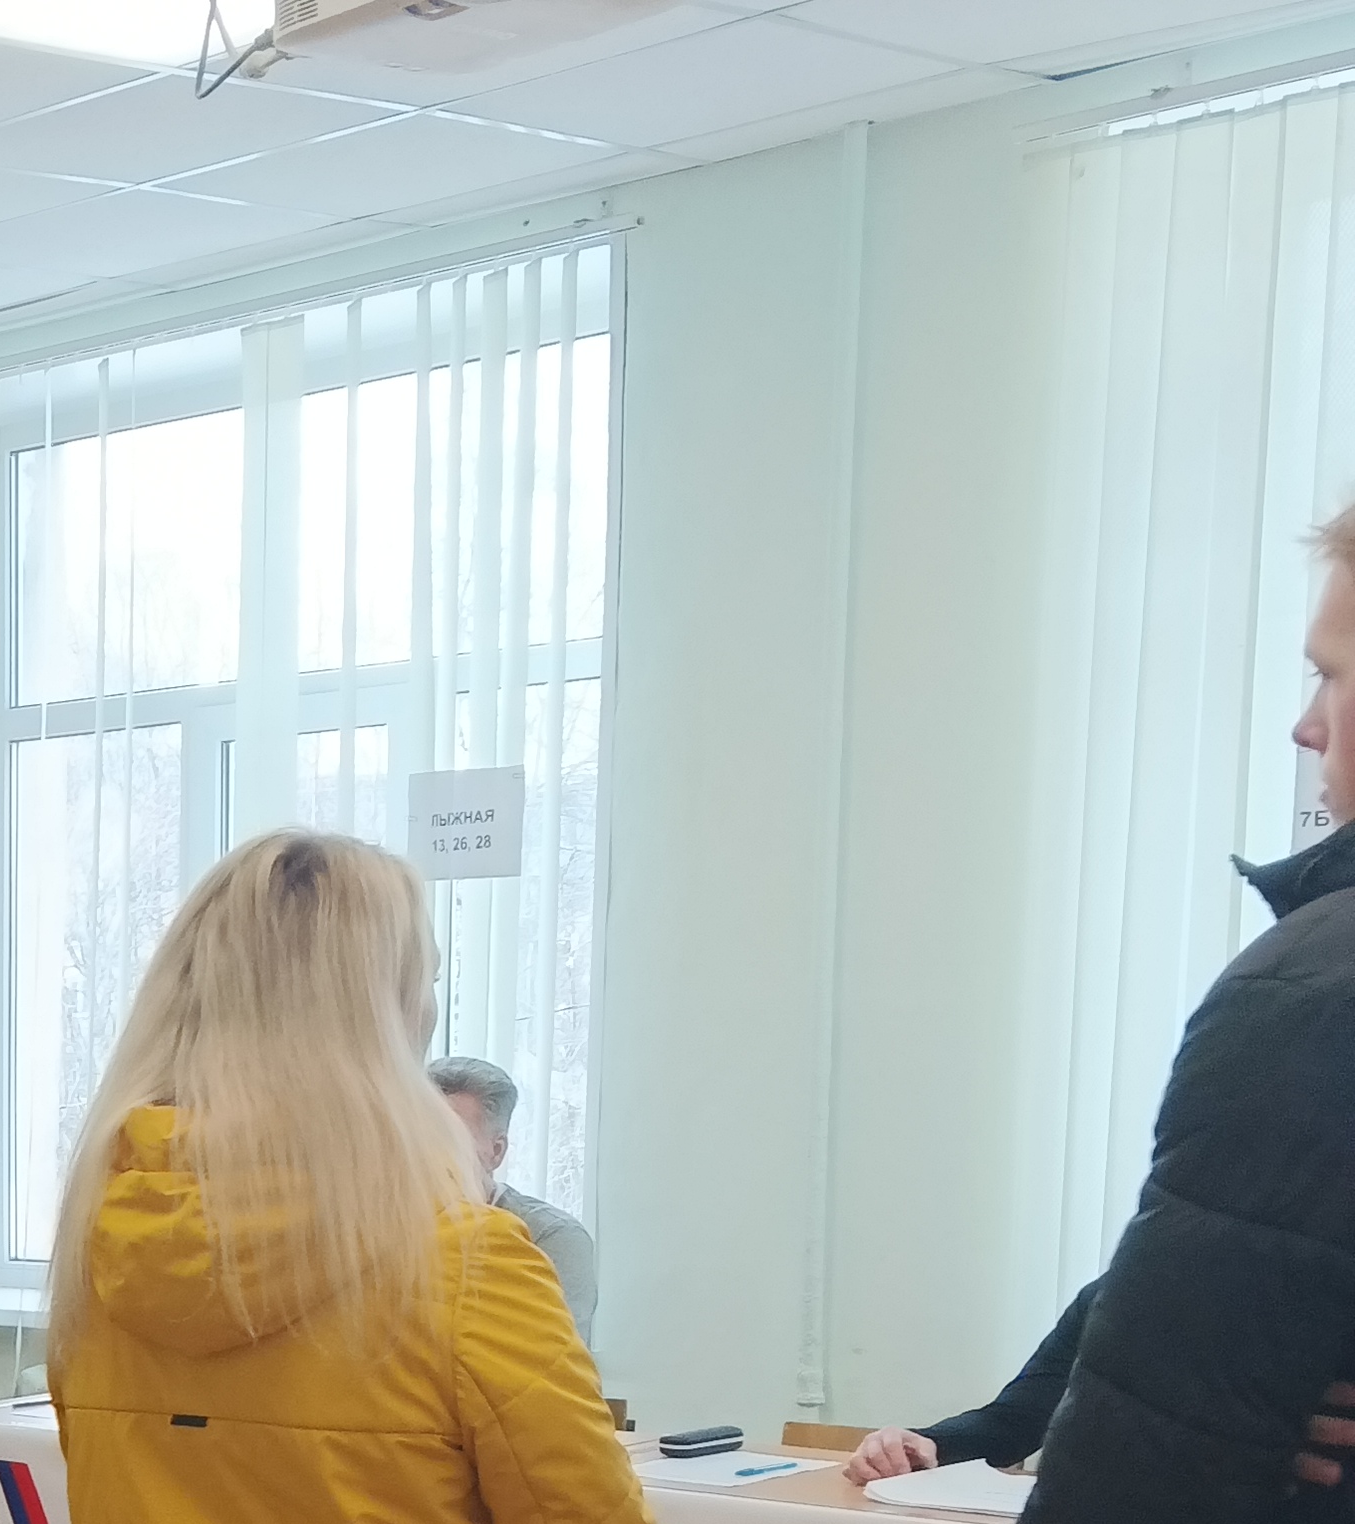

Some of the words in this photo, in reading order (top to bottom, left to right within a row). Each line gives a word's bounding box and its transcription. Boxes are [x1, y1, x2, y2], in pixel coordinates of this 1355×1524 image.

[431, 809, 495, 827] ЛЫЖНАЯ
[432, 838, 449, 853] 13,
[453, 837, 471, 853] 26,
[475, 835, 492, 849] 28
